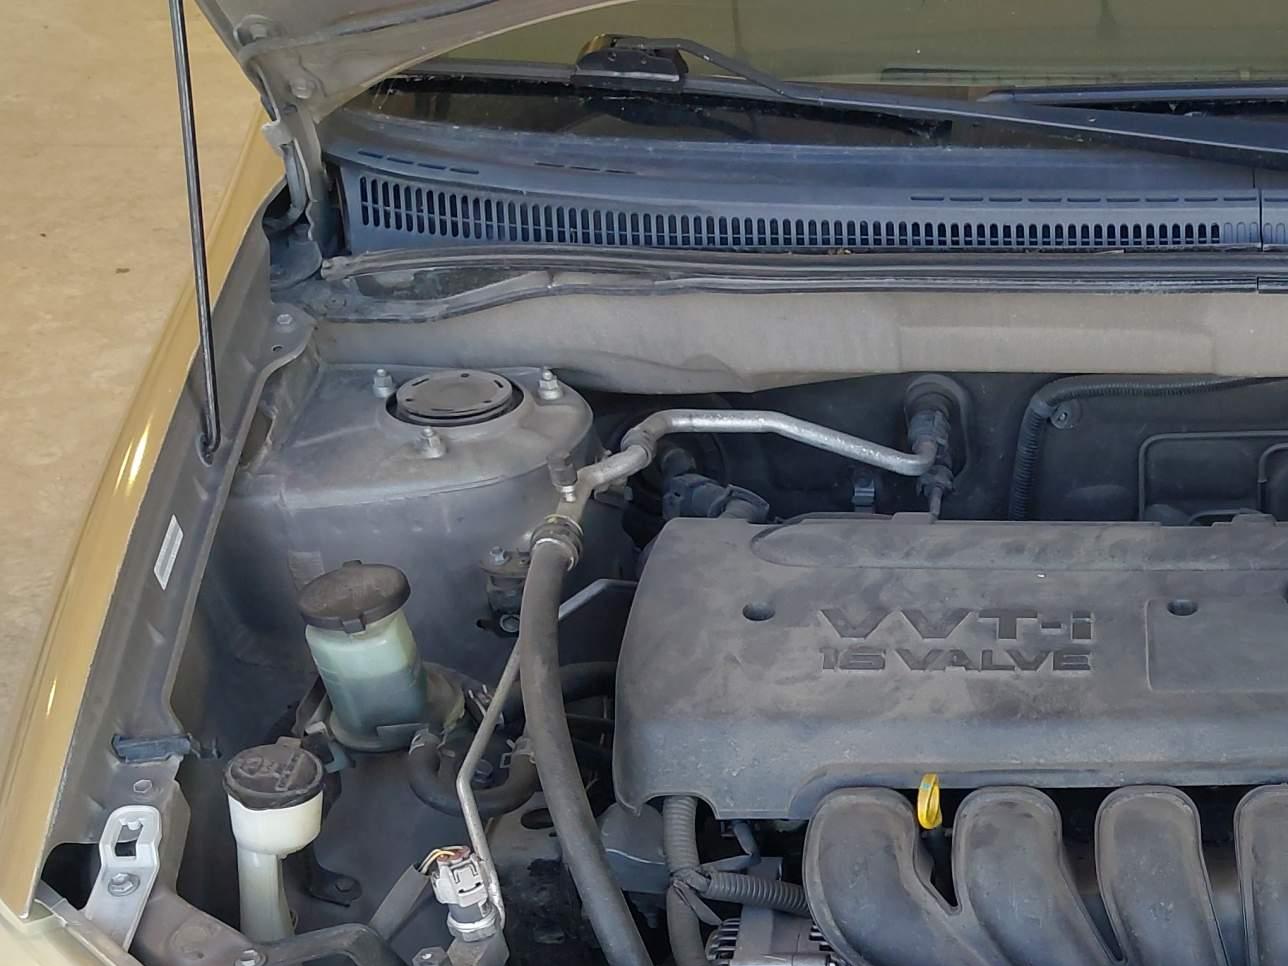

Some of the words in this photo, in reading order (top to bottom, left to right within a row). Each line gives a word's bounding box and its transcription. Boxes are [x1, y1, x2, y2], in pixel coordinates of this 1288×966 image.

[818, 607, 1094, 640] VVT-i
[820, 648, 887, 671] 16
[895, 649, 1092, 672] VALVE
